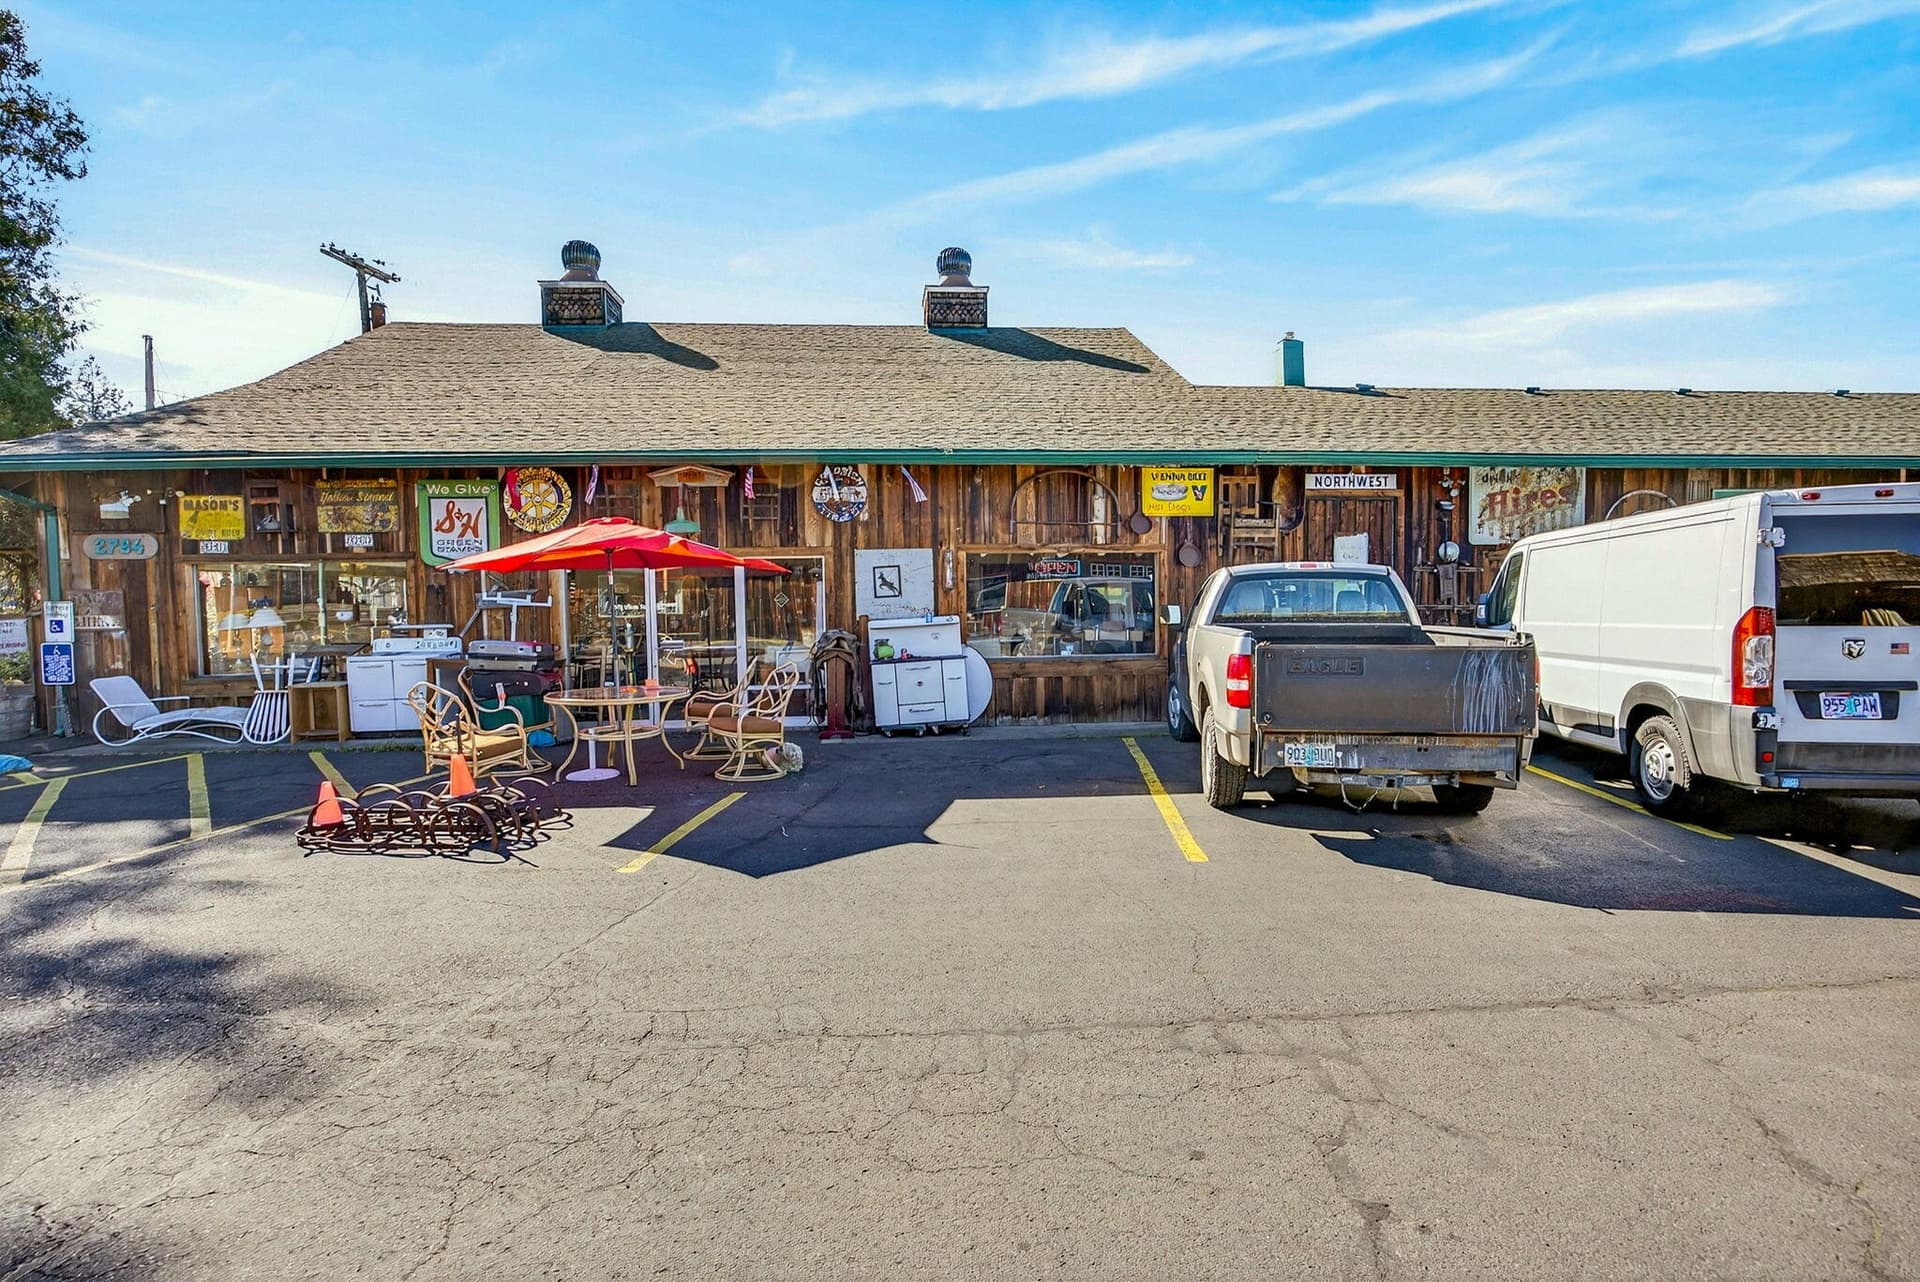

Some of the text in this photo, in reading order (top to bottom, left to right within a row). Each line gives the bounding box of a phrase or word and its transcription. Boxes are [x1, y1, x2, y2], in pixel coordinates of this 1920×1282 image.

[1314, 475, 1388, 488] NORTHWEST
[427, 484, 491, 494] We Give
[183, 500, 239, 511] MASON'S
[1034, 561, 1077, 574] OPEN
[1292, 657, 1361, 673] EAGLE
[1823, 698, 1847, 712] 955
[1287, 747, 1306, 760] 903
